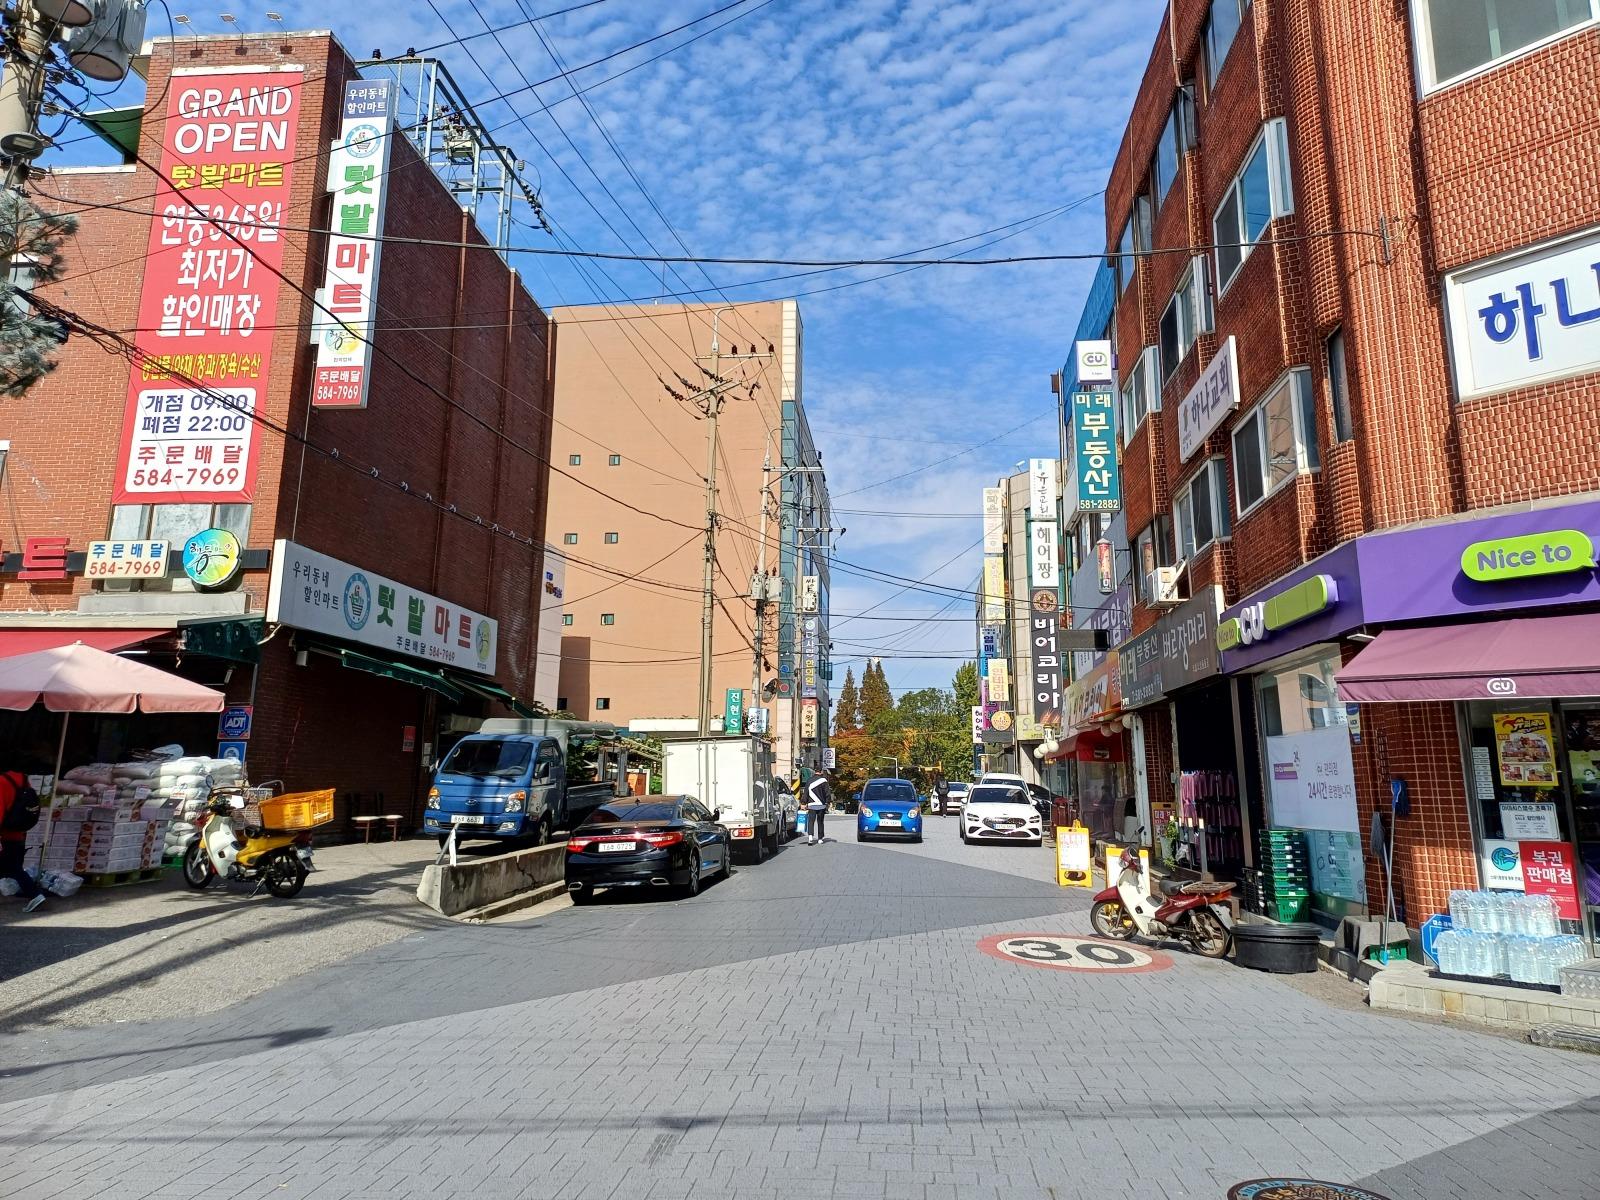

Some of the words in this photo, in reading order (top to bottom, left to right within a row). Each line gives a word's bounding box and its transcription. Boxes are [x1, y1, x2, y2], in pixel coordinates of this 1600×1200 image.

[178, 84, 293, 119] GRAND
[347, 87, 387, 101] 우리동네
[346, 102, 386, 115] 할인마트
[174, 120, 288, 155] OPEN
[170, 161, 284, 190] 텃밭마트
[161, 200, 282, 246] 연중365일
[330, 164, 375, 313] 텃밭마트
[177, 246, 254, 290] 최저가
[155, 293, 261, 340] 할인매장
[1087, 355, 1102, 364] CU
[320, 370, 361, 383] 주문배달
[145, 394, 184, 413] 개점
[190, 394, 249, 412] 09:00
[317, 385, 359, 400] 584-7969
[1076, 394, 1111, 408] 미래
[1191, 354, 1230, 432] 하나교회
[142, 416, 181, 434] 폐점
[187, 416, 246, 432] 22:00
[1081, 413, 1112, 495] 부동산
[133, 468, 239, 486] 584-7969
[1080, 499, 1119, 510] 581-2882
[0, 537, 71, 580] 트
[1037, 526, 1053, 579] 헤어짱
[1477, 549, 1537, 571] Nice
[1541, 544, 1572, 564] to
[89, 560, 161, 576] 584-7969
[292, 561, 330, 588] 우리동네
[304, 586, 339, 611] 할인마트
[377, 584, 472, 649] 텃밭마트
[1240, 602, 1264, 645] CU
[1137, 633, 1158, 662] 부동산
[1034, 618, 1061, 708] 비어코리아
[1492, 681, 1511, 691] CU
[225, 717, 246, 728] ADT
[1308, 782, 1327, 799] 24시간
[1532, 850, 1563, 867] 복권
[1527, 867, 1573, 884] 판매점
[1008, 939, 1135, 965] 30
